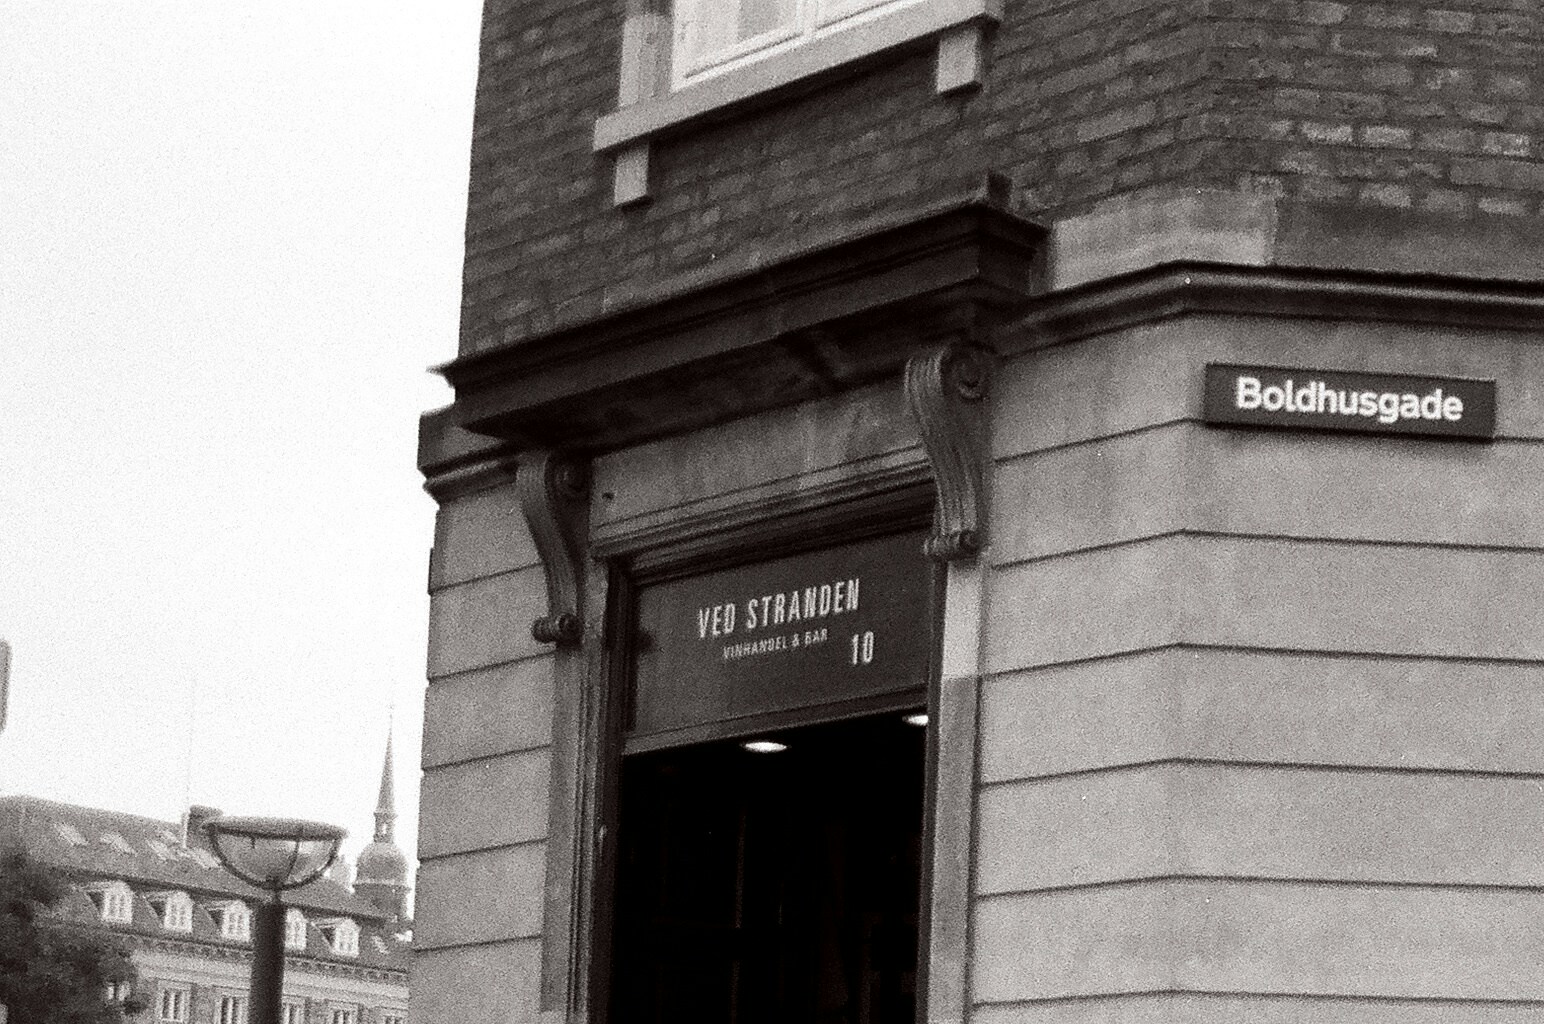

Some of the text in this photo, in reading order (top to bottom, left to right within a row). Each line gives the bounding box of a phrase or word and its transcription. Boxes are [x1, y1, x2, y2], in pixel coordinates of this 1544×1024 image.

[1236, 376, 1463, 423] Boldhusgade
[699, 578, 860, 638] VED STRANDEN
[723, 628, 828, 659] VINHANDEL & BAR
[852, 631, 874, 665] 10
